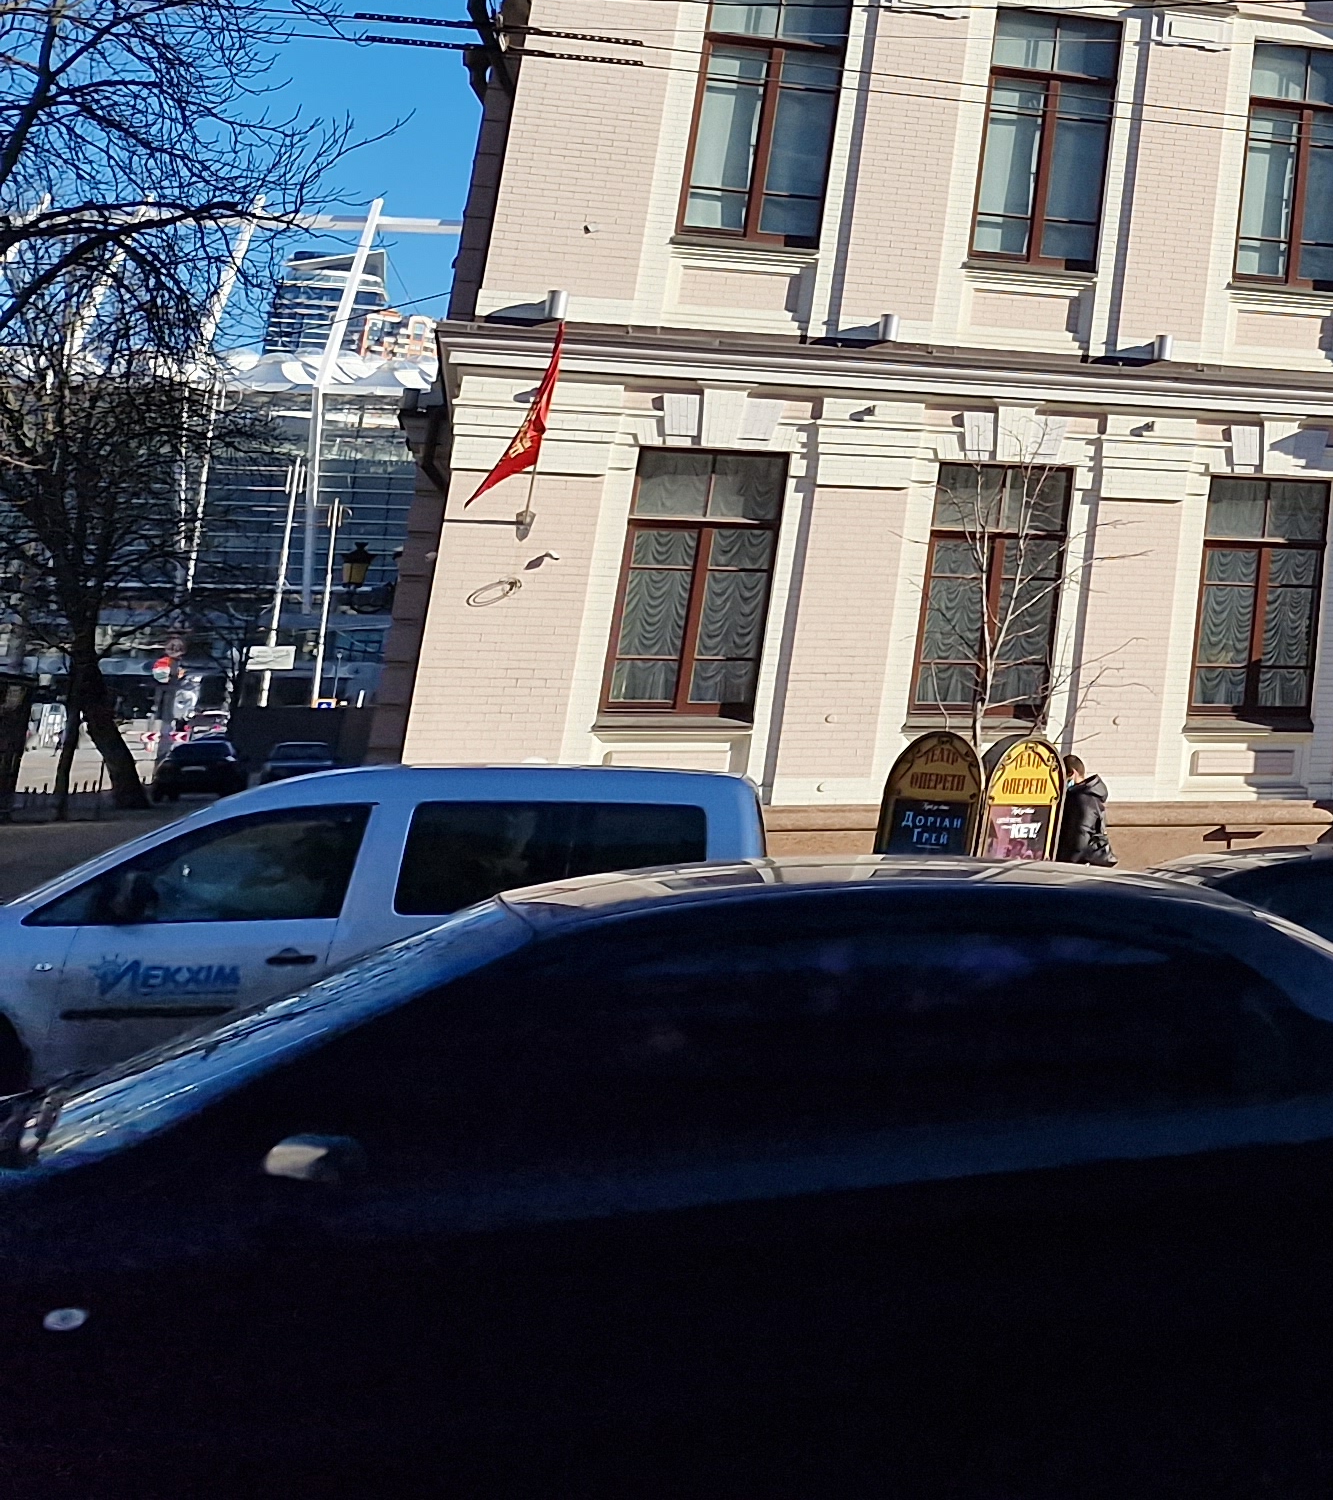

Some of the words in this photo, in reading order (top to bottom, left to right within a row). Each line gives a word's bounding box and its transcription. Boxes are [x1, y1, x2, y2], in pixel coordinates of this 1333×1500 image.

[1014, 752, 1042, 770] ТЕАТР
[910, 772, 966, 791] ОПЕРЕТИ
[1002, 778, 1048, 794] ОПЕРЕТИ
